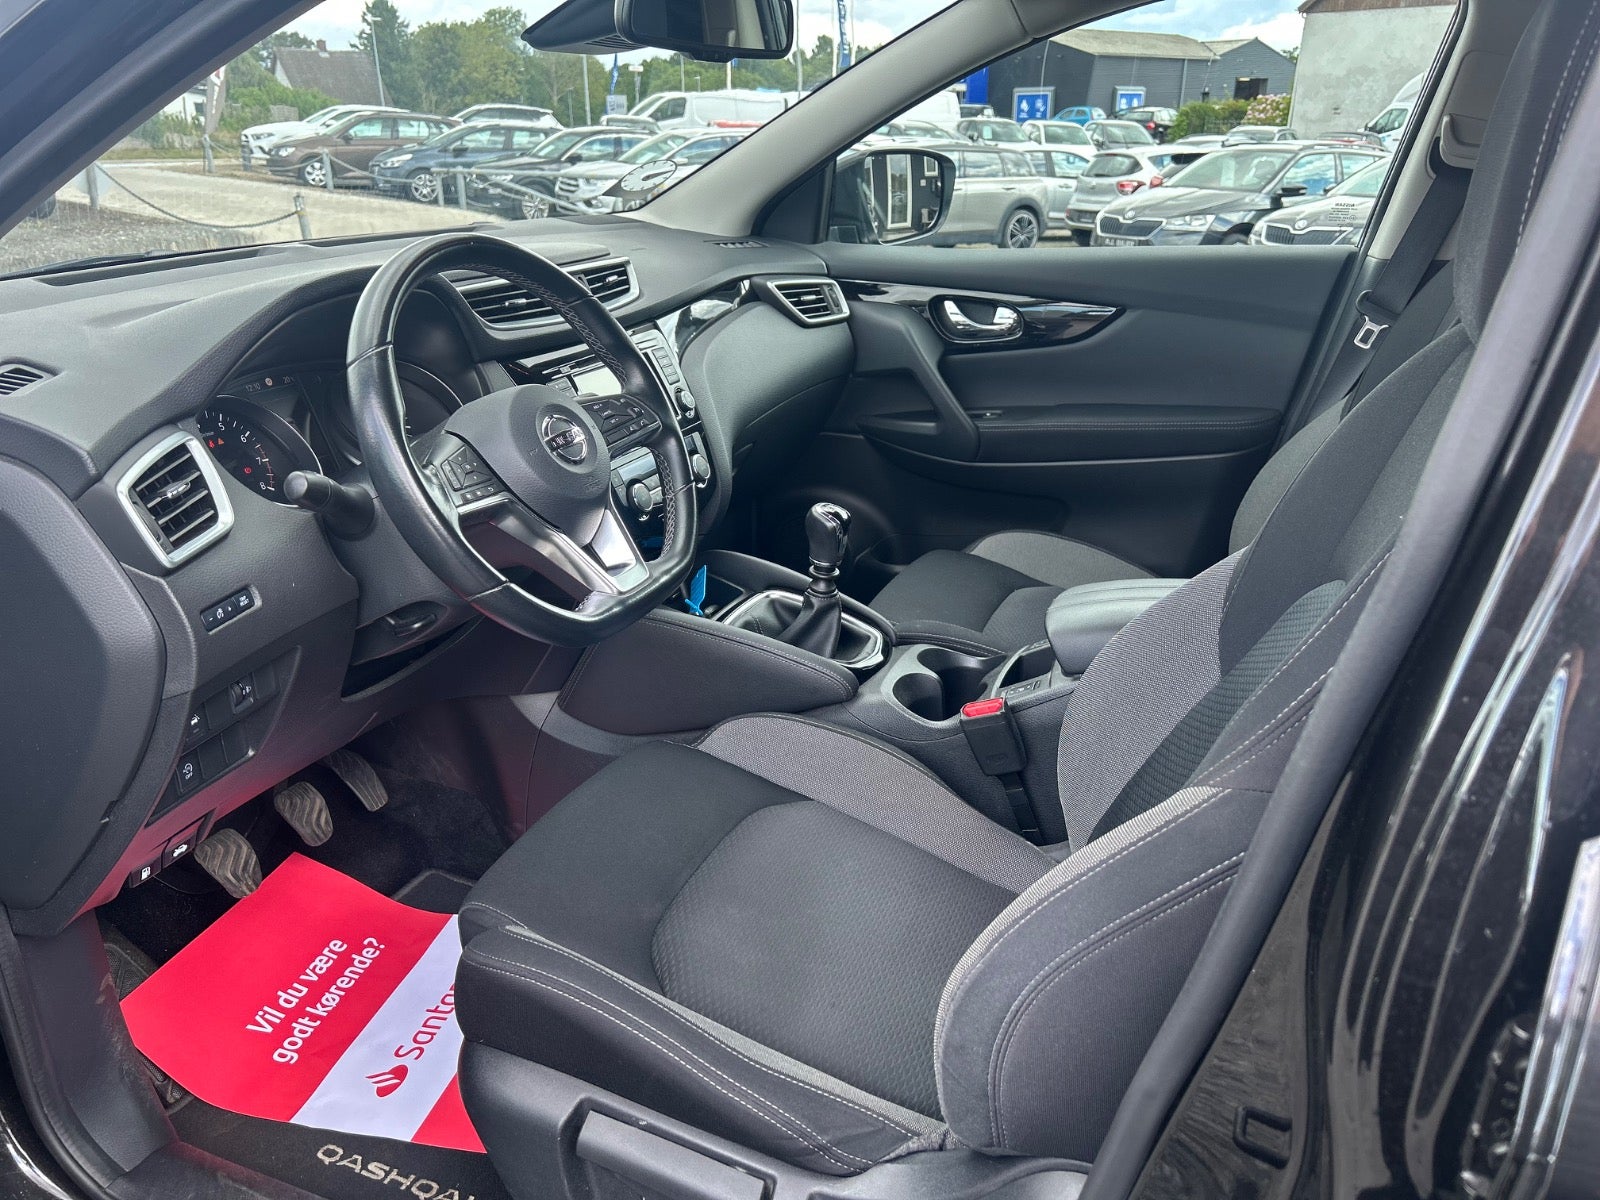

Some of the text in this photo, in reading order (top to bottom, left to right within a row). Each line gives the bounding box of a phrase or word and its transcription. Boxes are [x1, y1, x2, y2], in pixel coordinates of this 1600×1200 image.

[240, 434, 247, 443] 6
[255, 457, 262, 465] 7
[259, 482, 267, 490] 8
[245, 939, 348, 1033] Vil du være
[272, 937, 386, 1065] godt kørende?
[393, 983, 455, 1060] Santa
[316, 1143, 475, 1200] QASHQA
